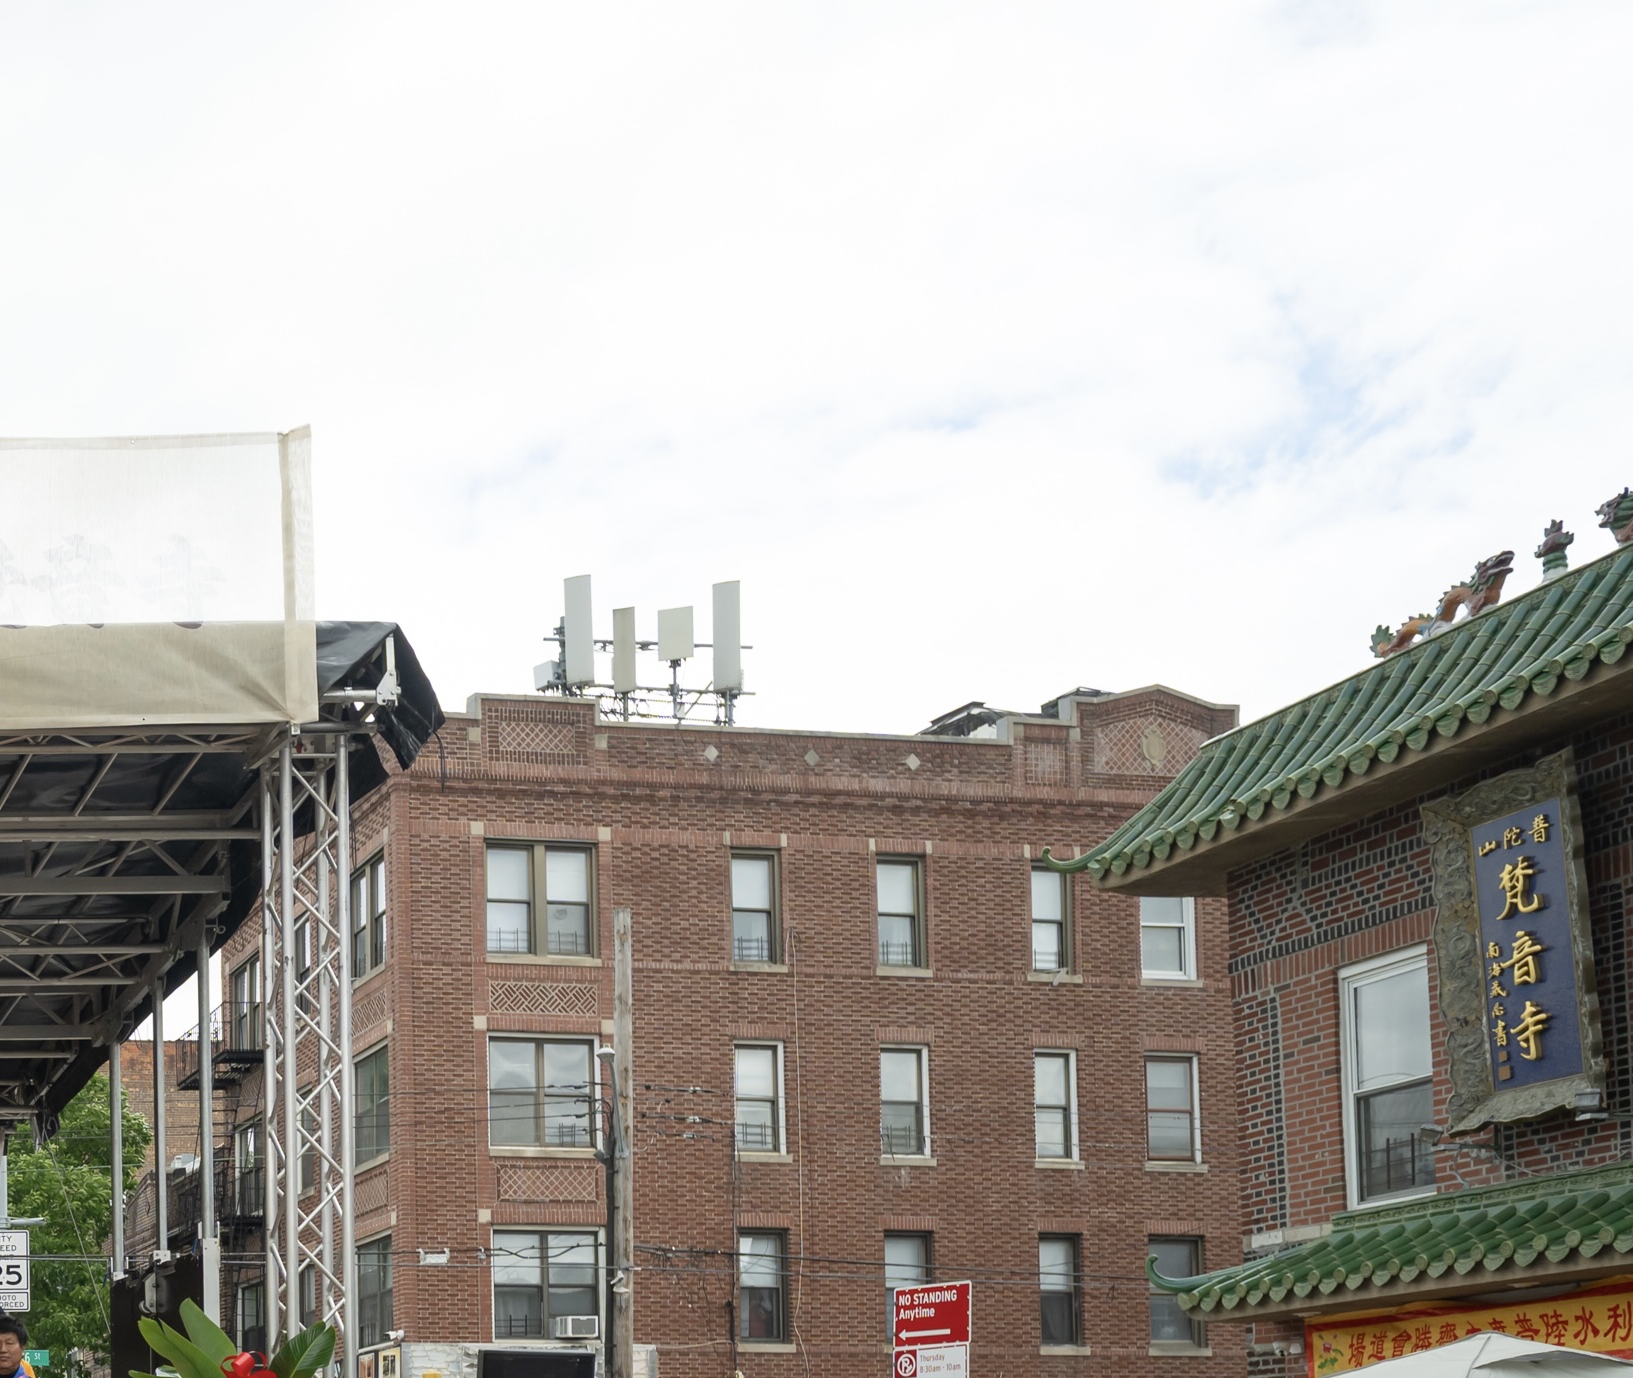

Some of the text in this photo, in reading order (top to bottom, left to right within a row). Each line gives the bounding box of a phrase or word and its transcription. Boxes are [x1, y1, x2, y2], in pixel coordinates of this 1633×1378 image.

[1478, 814, 1552, 857] 普陀山
[1496, 856, 1547, 1061] 梵音寺
[0, 1244, 17, 1252] EED
[899, 1289, 957, 1306] NO STANDING
[899, 1306, 935, 1321] Anytime
[920, 1354, 945, 1363] Thursday
